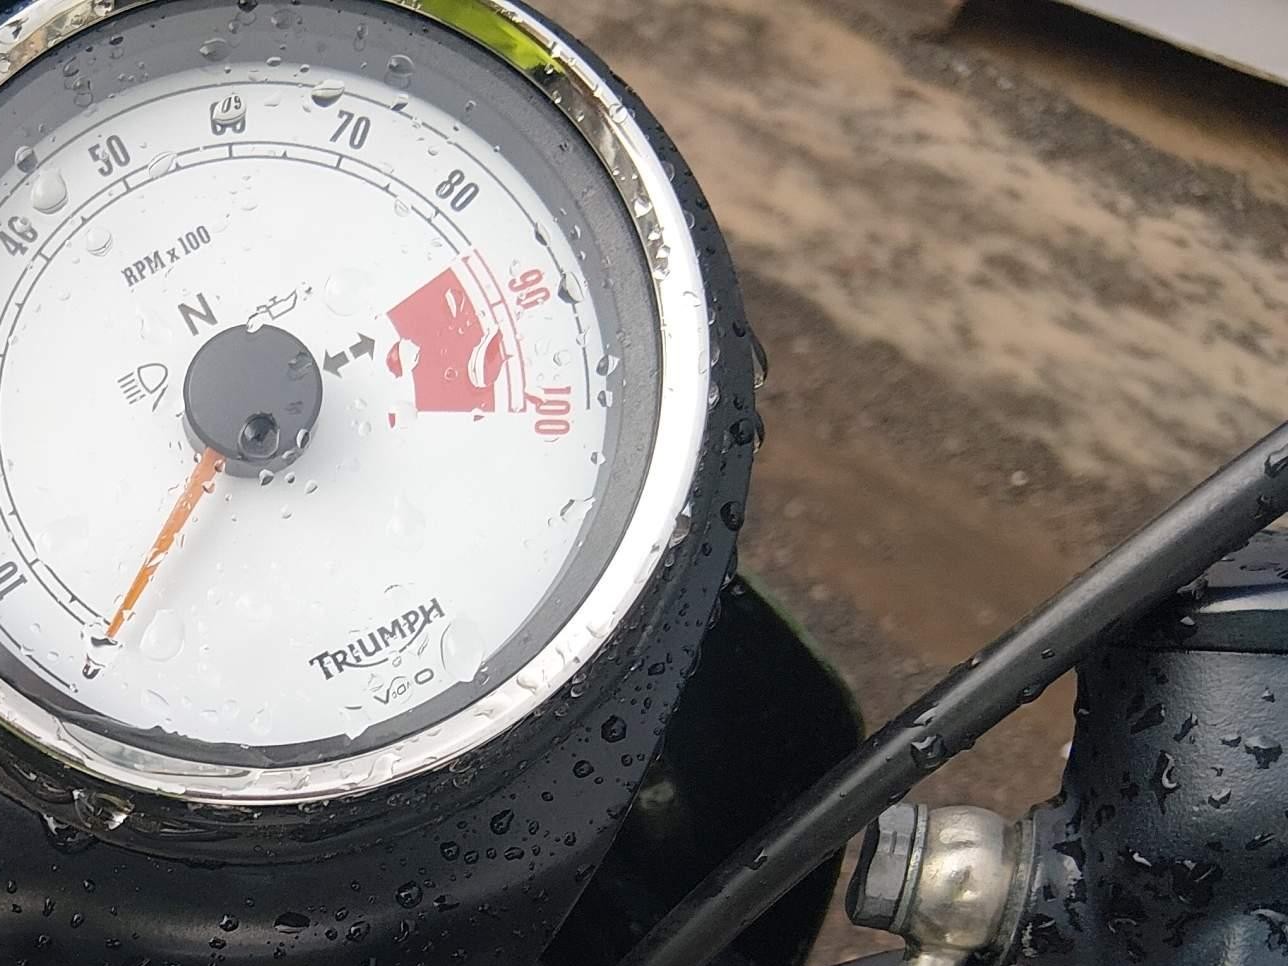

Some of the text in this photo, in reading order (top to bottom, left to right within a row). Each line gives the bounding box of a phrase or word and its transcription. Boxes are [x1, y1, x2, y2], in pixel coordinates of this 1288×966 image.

[329, 110, 372, 150] 70
[88, 134, 131, 177] 50
[435, 169, 480, 212] 80
[120, 250, 166, 287] RPM
[177, 225, 211, 255] 100
[508, 269, 551, 310] 90
[177, 292, 218, 336] N
[534, 386, 571, 435] 100
[308, 597, 445, 681] TRIUMPH
